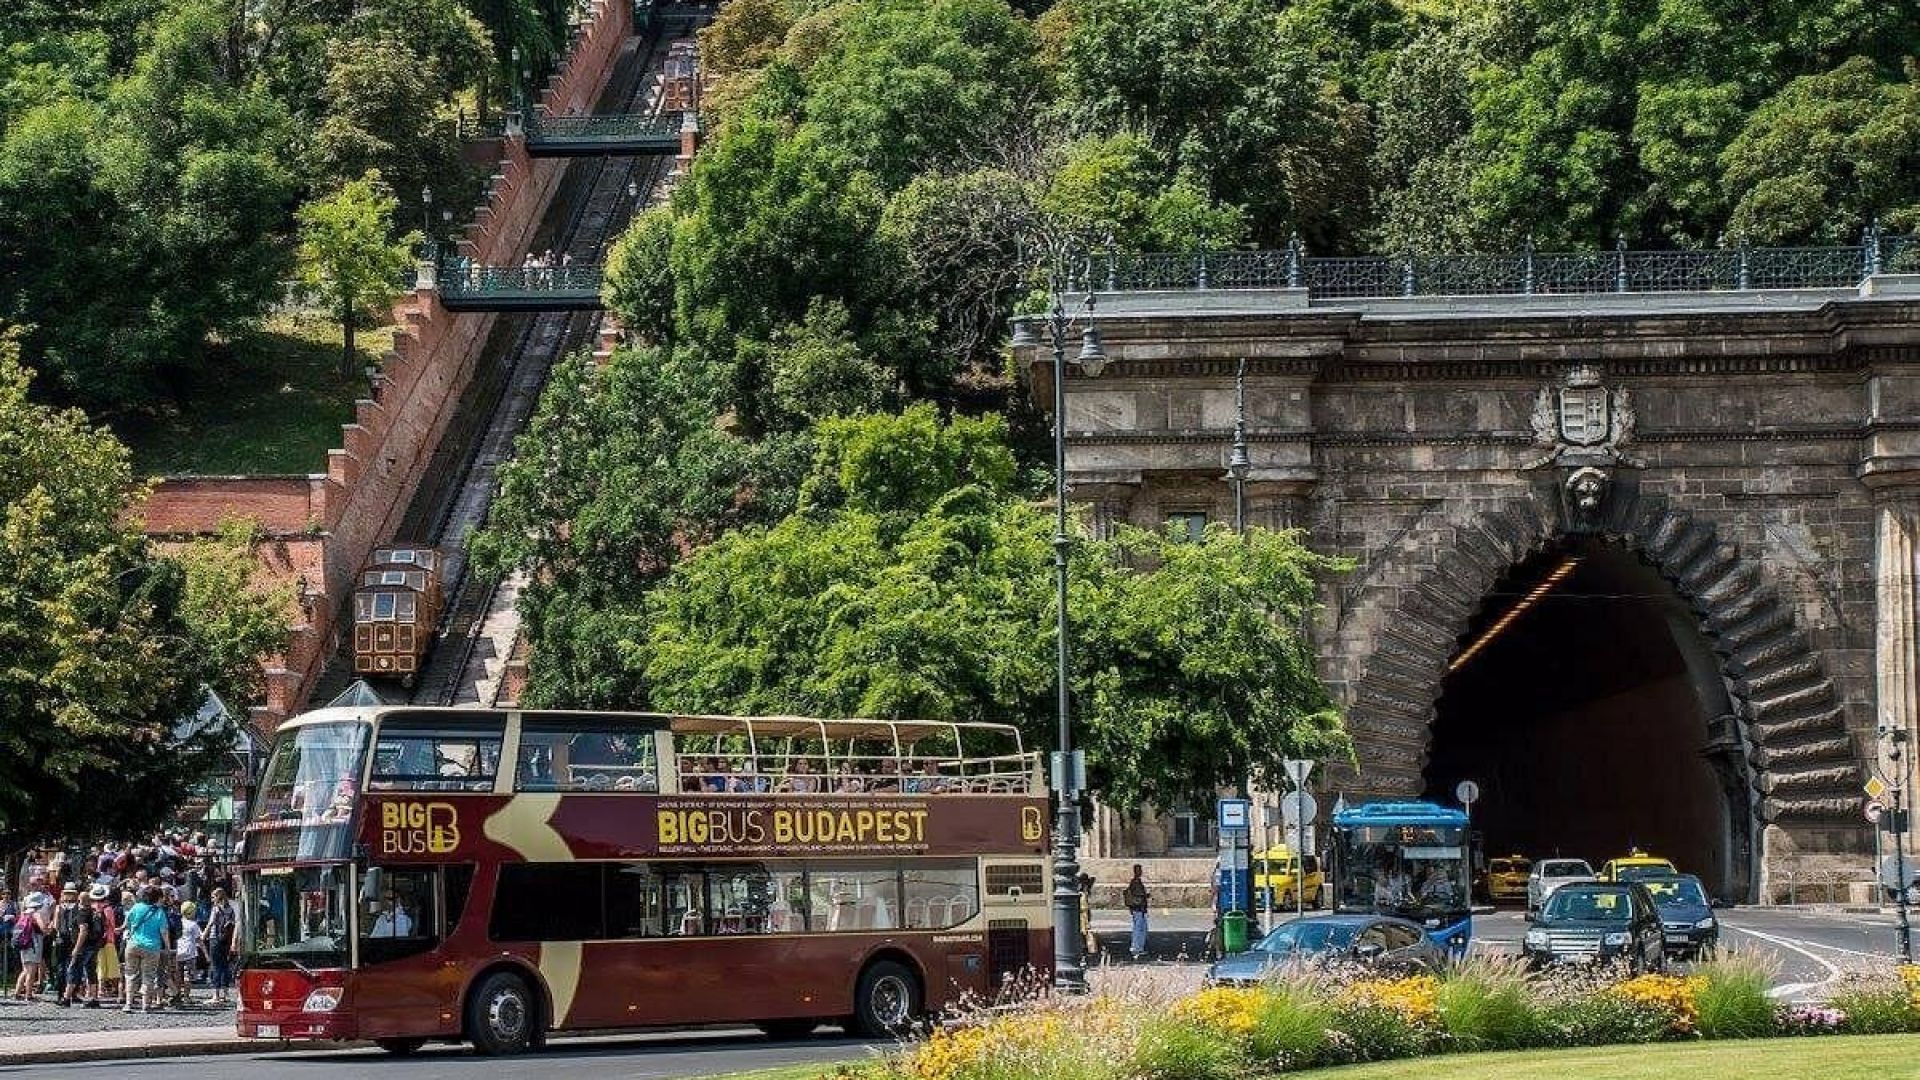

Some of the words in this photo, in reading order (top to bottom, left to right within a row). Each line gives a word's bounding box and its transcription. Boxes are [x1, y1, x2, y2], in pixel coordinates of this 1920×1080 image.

[383, 802, 425, 828] BIG
[773, 810, 929, 843] BUDAPEST
[383, 830, 425, 852] BUS
